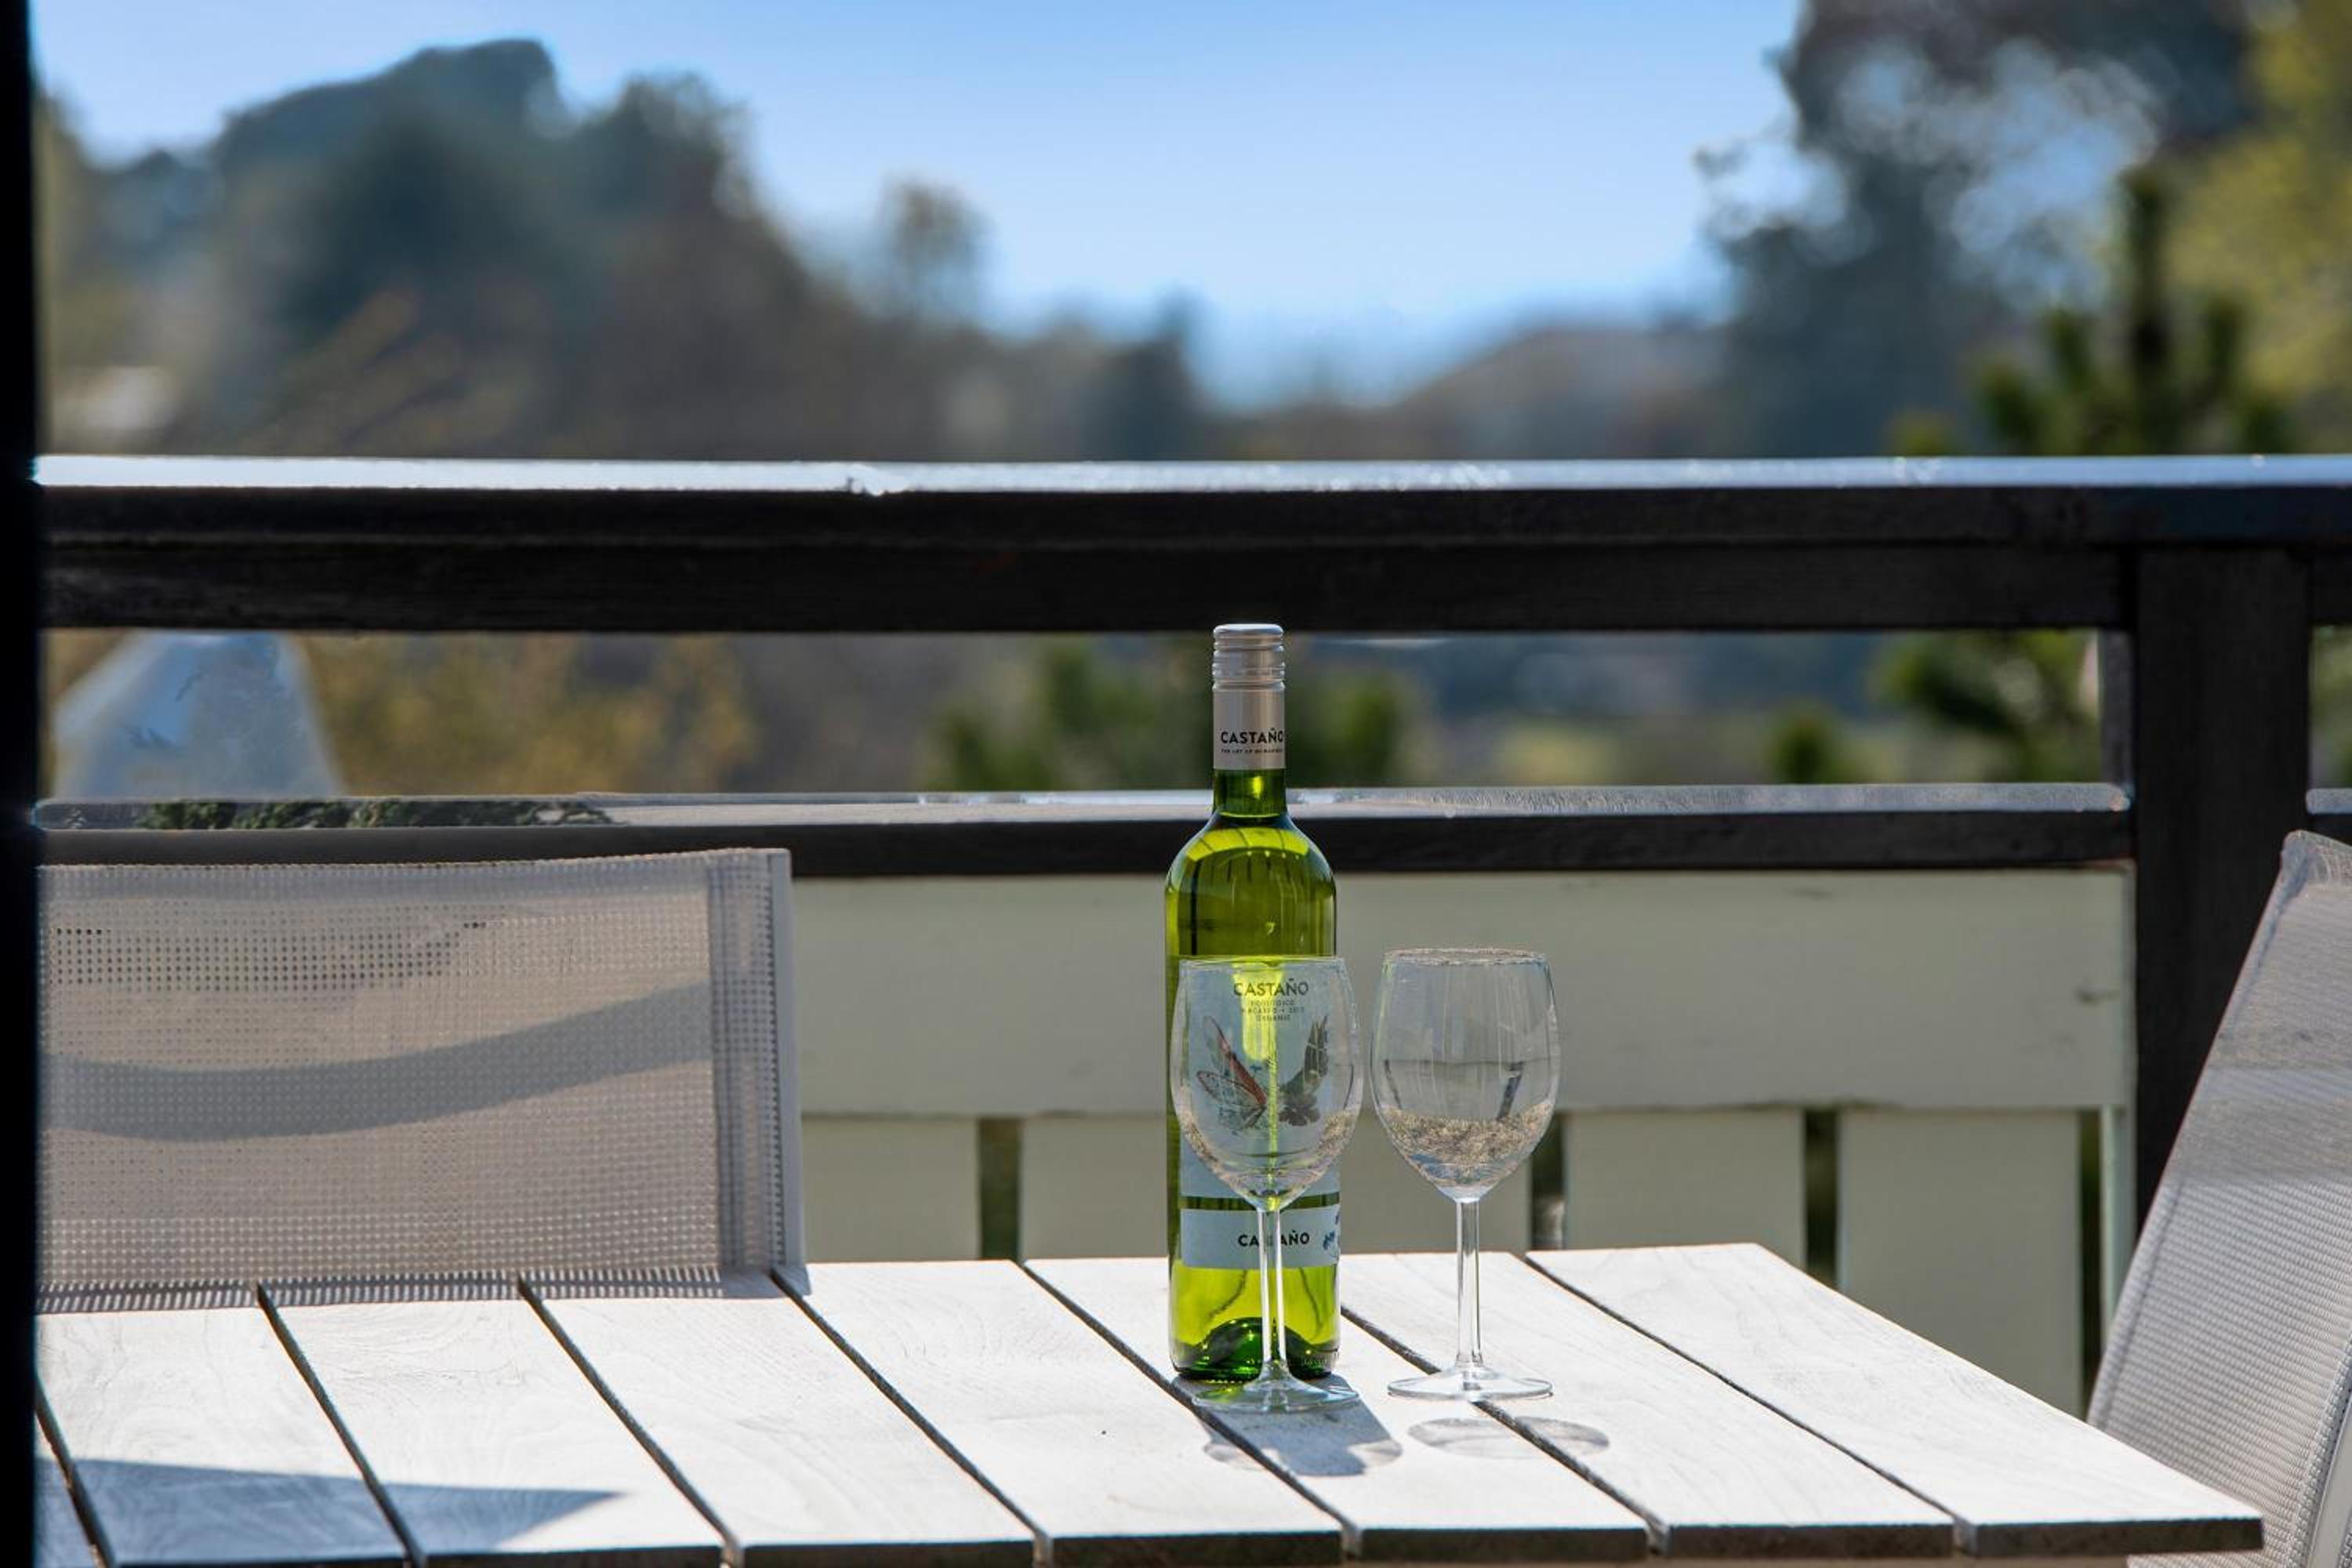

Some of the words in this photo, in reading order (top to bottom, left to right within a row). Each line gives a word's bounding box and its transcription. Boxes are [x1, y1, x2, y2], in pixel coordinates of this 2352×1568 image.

[1221, 728, 1283, 743] CASTAÑO
[1233, 978, 1308, 996] CASTAÑO
[1238, 1229, 1310, 1247] CAAÑO
